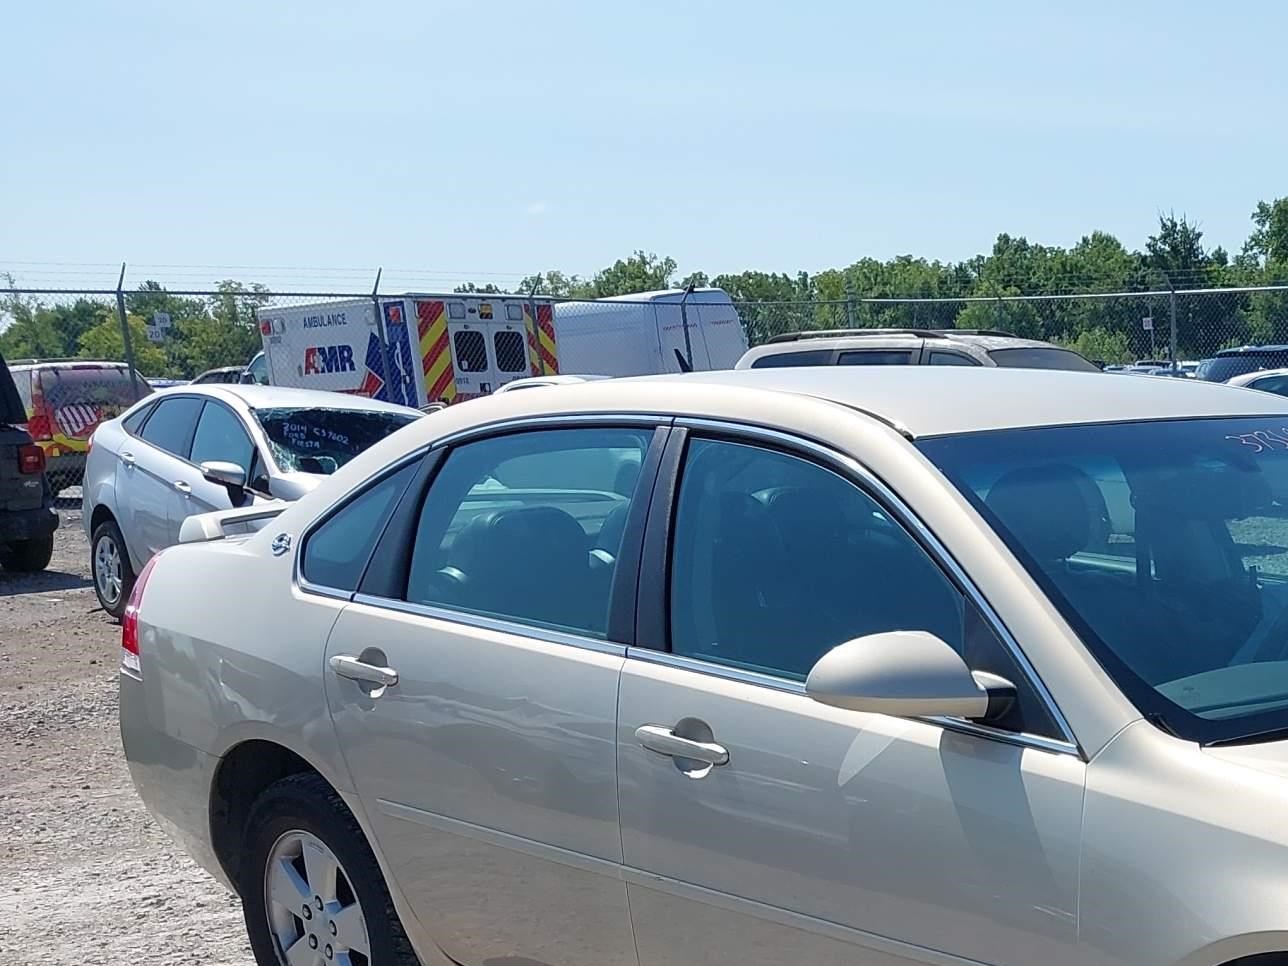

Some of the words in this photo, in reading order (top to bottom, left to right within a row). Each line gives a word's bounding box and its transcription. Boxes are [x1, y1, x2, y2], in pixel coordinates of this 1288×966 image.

[303, 312, 347, 329] AMBULANCE
[304, 344, 356, 375] AMR
[282, 422, 307, 434] 2014
